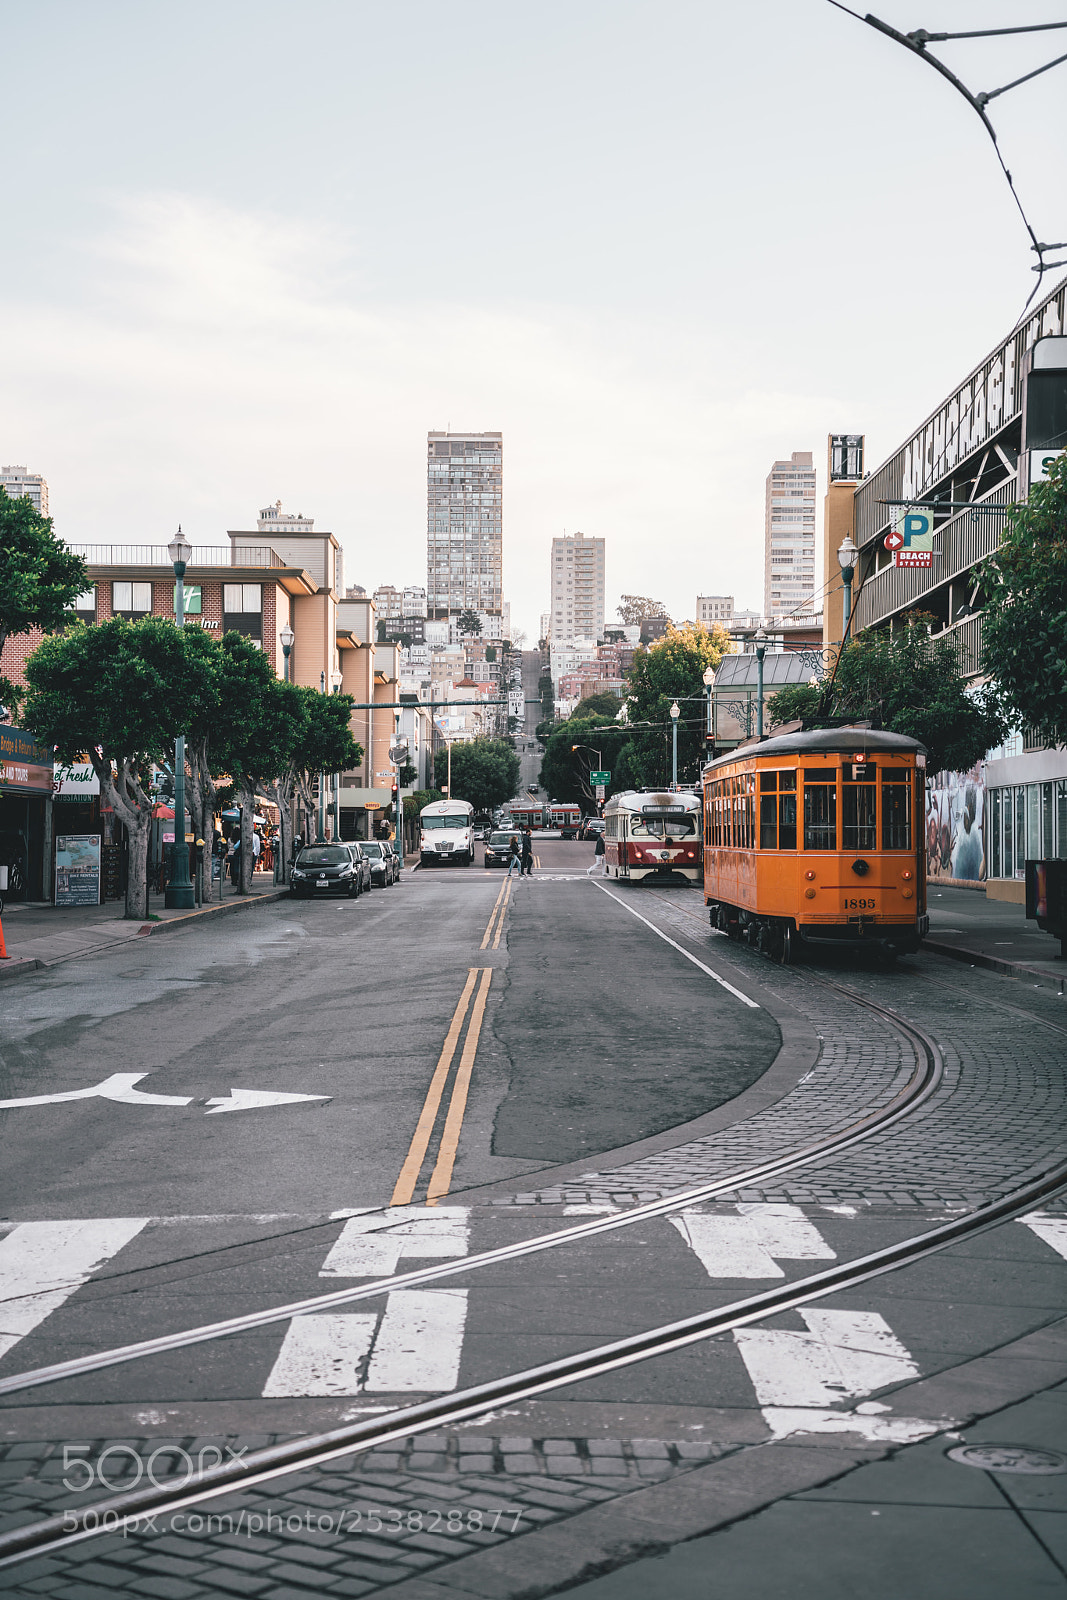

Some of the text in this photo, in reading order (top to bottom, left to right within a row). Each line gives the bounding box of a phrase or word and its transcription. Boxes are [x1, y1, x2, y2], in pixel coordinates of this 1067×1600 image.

[904, 514, 929, 547] P
[899, 552, 931, 560] BEACH
[201, 617, 219, 629] Inn
[0, 735, 14, 756] Bridge
[18, 739, 32, 756] Return
[6, 766, 14, 780] AND
[15, 767, 29, 782] TOURS
[851, 764, 867, 780] F
[843, 898, 876, 910] 1895
